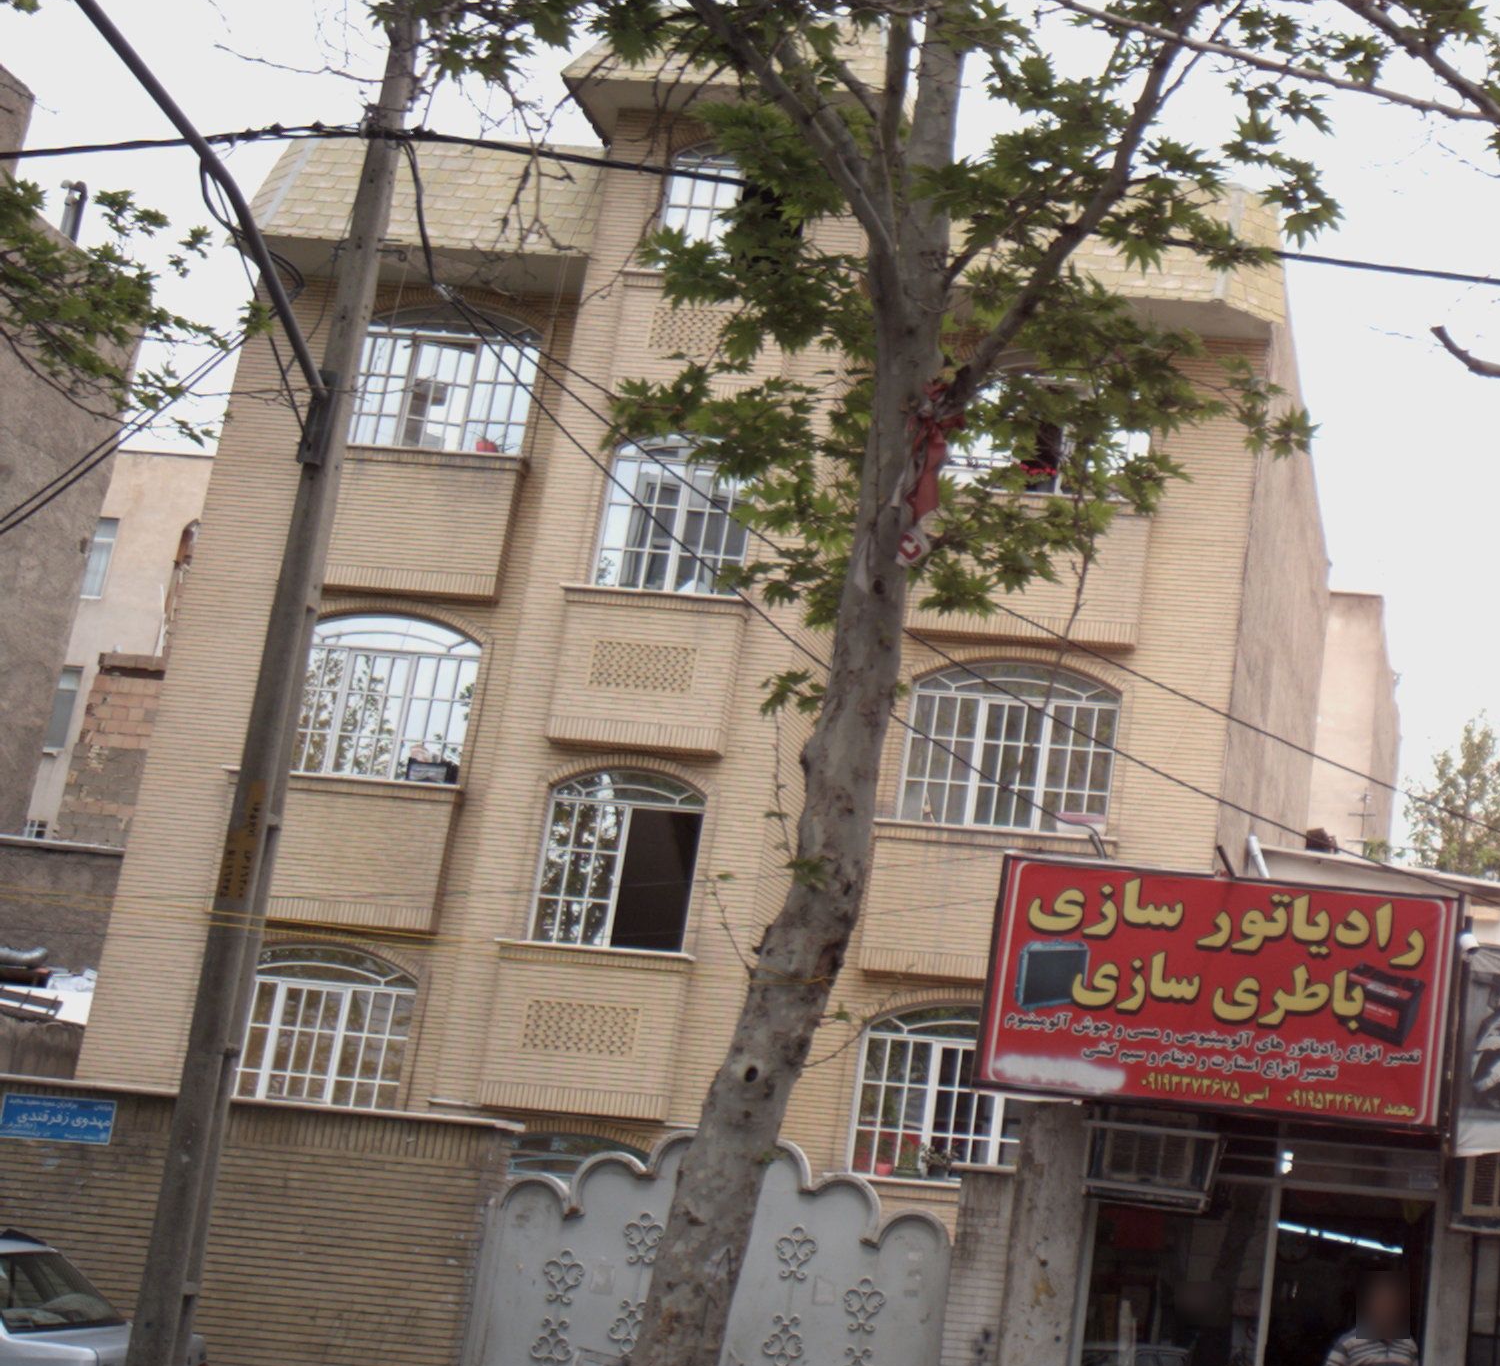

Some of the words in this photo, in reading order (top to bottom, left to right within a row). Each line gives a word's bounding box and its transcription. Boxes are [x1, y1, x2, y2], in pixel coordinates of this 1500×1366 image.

[1028, 878, 1184, 937] سازی
[1196, 894, 1425, 968] رادیاتور
[1071, 952, 1200, 1012] سازی
[1212, 965, 1366, 1033] باطری
[1072, 1016, 1111, 1037] جوش
[1114, 1023, 1125, 1039] و
[1126, 1025, 1160, 1040] مسی
[1162, 1028, 1173, 1043] و
[1081, 1041, 1119, 1060] کشی
[1254, 1036, 1285, 1053] های
[1289, 1038, 1342, 1062] رادیاتور
[1119, 1048, 1146, 1063] سیم
[1147, 1051, 1158, 1065] و
[1159, 1051, 1197, 1066] دینام
[1346, 1045, 1382, 1063] انواع
[1384, 1048, 1423, 1066] تعمیر
[1198, 1057, 1208, 1071] و
[1210, 1056, 1260, 1074] استارت
[1262, 1060, 1299, 1079] انواع
[1299, 1064, 1340, 1082] تعمیر
[71, 1116, 112, 1129] مهدوی
